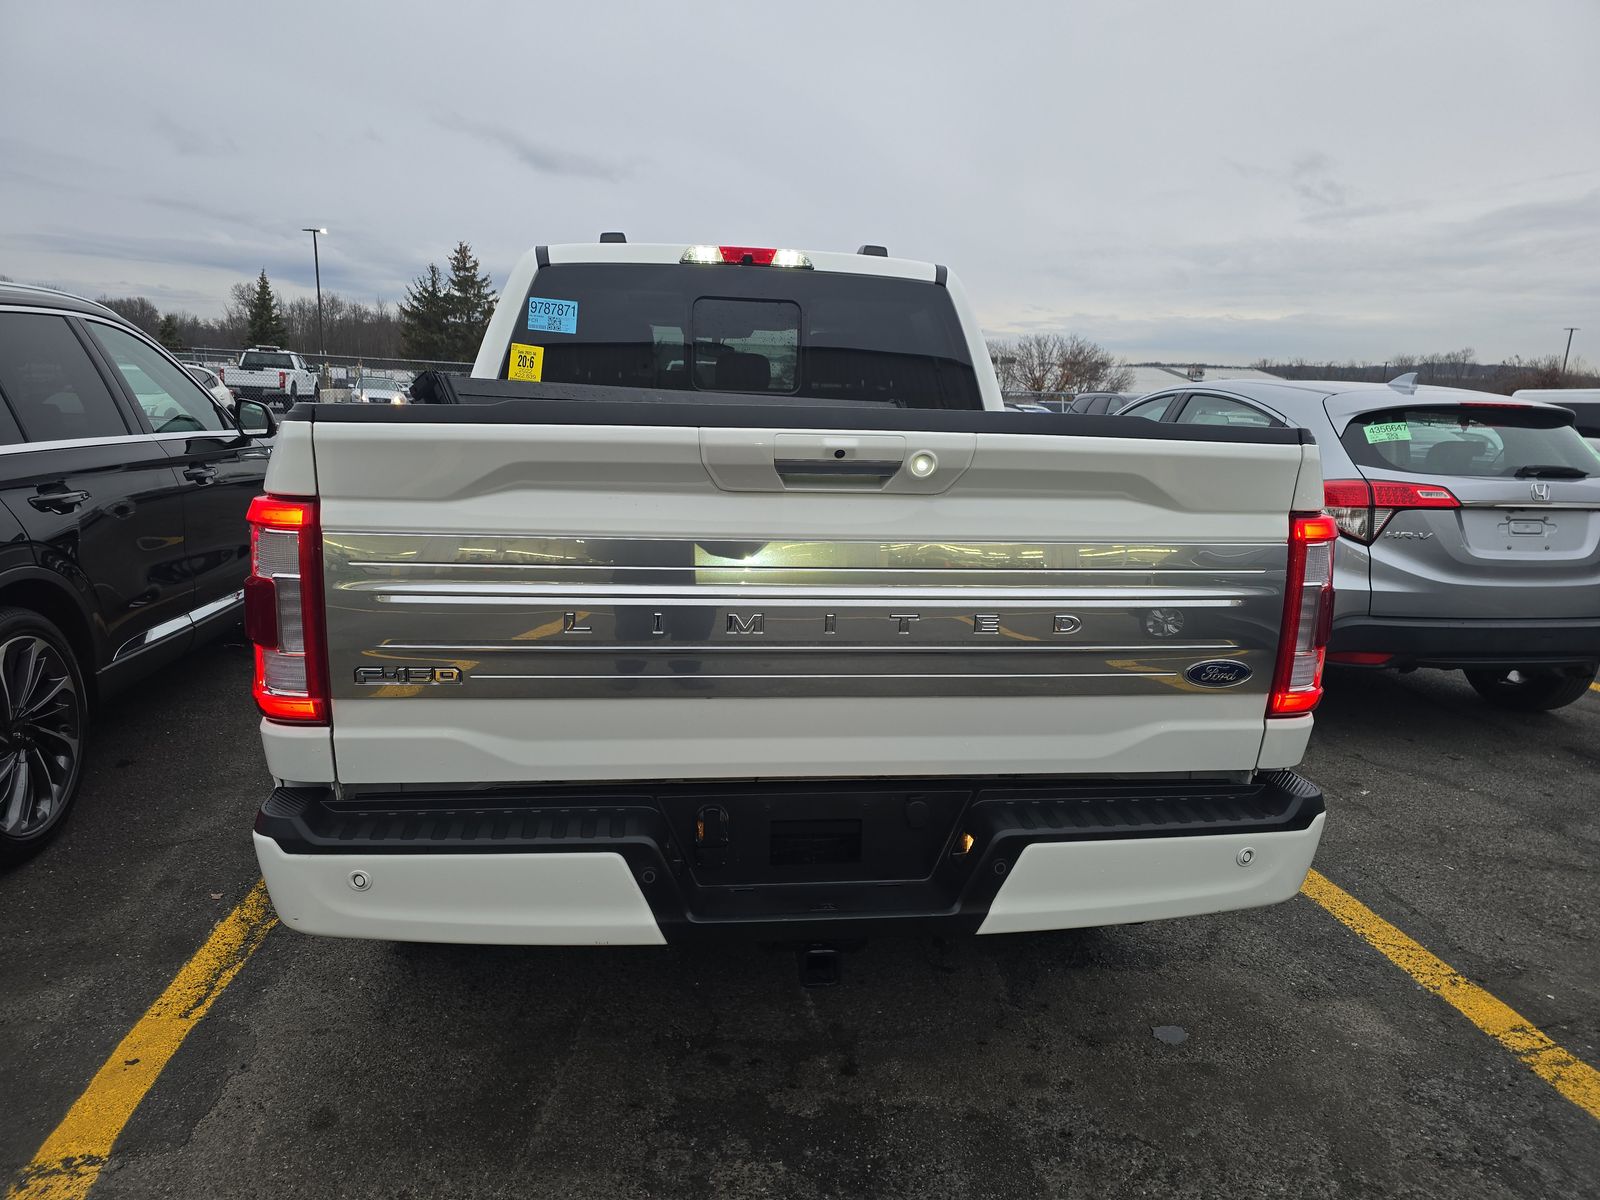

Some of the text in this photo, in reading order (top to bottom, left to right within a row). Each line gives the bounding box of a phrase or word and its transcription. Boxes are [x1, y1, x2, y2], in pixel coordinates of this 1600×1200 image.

[530, 301, 576, 317] 9787871
[517, 354, 535, 369] 20:6
[1384, 531, 1434, 541] HR-V
[563, 612, 1083, 636] LIMITED
[354, 666, 463, 686] F-150
[1201, 665, 1239, 681] Ford
